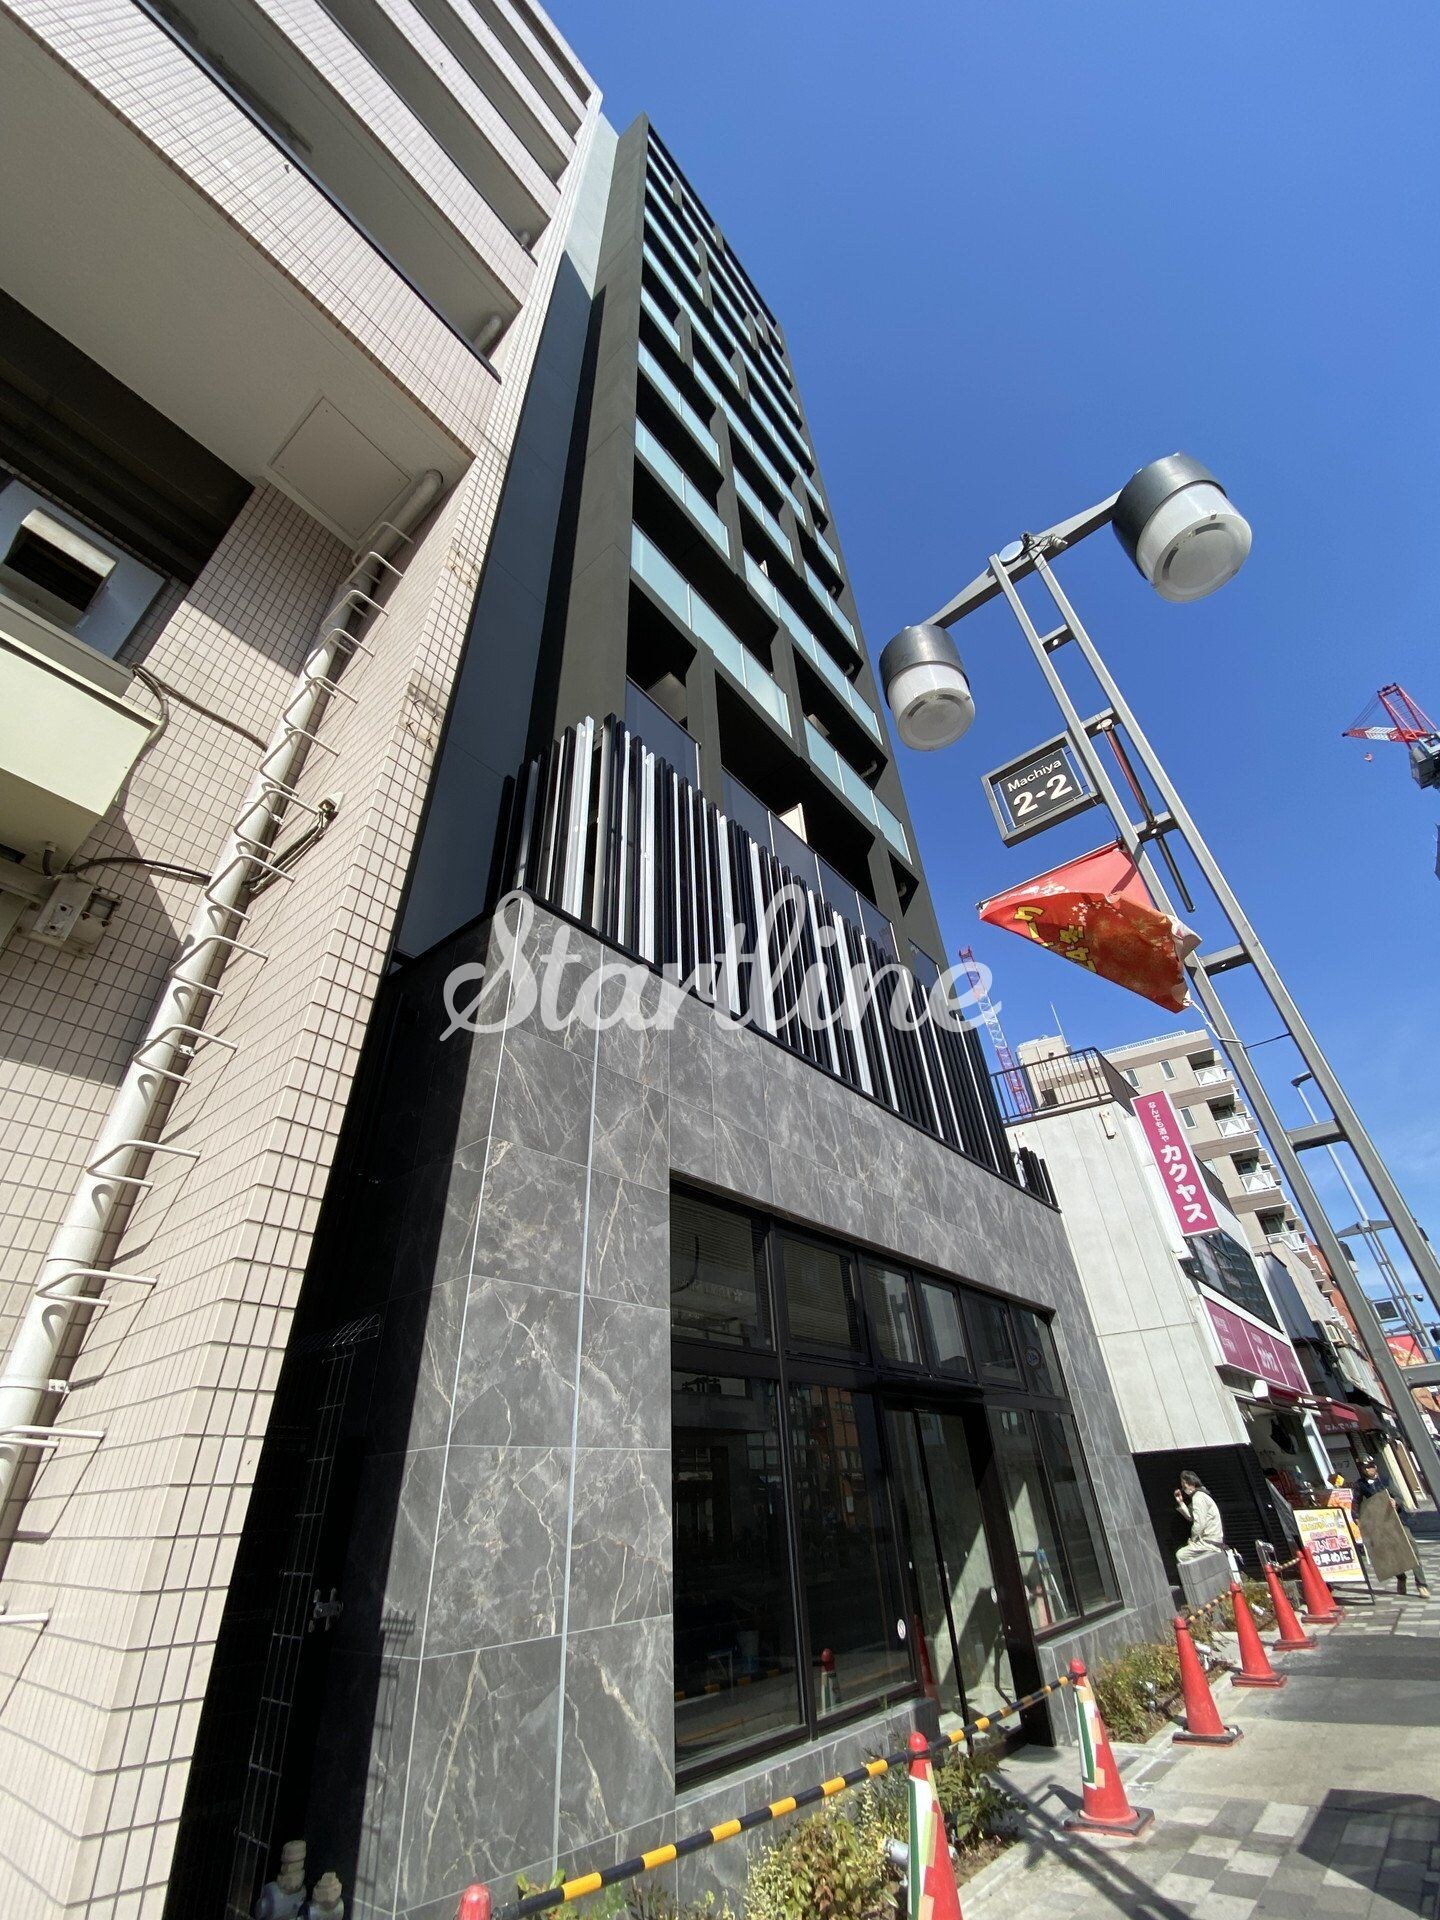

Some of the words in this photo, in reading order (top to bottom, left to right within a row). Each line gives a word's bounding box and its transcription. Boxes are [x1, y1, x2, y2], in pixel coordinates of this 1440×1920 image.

[1007, 760, 1062, 792] Machiya
[1014, 774, 1073, 817] 2-2
[1160, 1144, 1208, 1223] カクヤス
